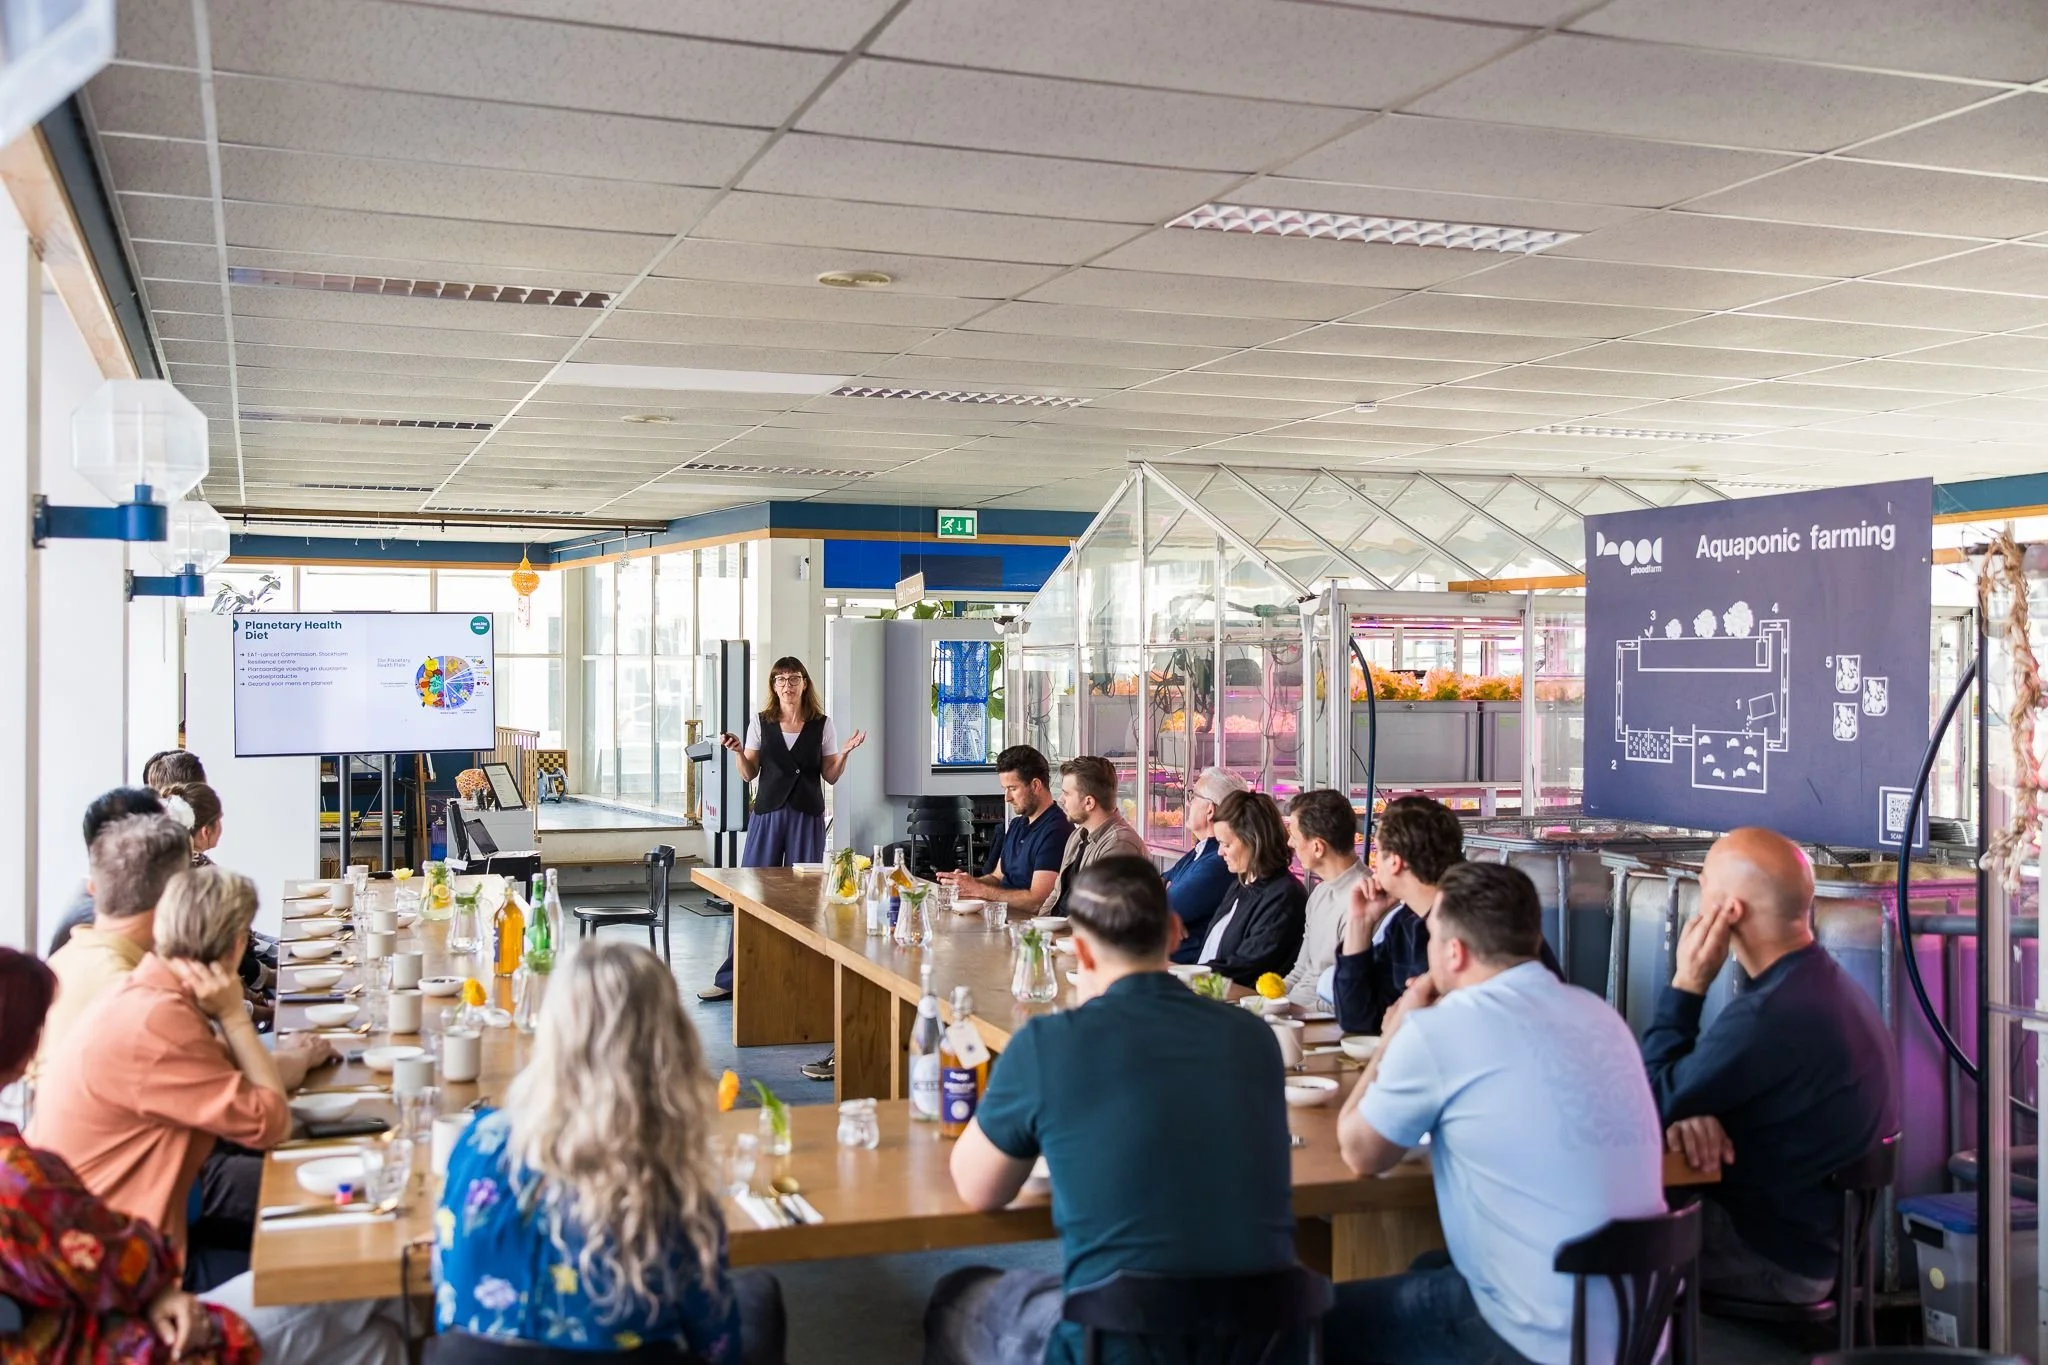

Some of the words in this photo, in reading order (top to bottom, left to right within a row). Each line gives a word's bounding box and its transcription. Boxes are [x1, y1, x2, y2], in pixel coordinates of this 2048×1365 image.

[1696, 527, 1801, 562] Aquaponic
[1810, 520, 1896, 551] farming
[1630, 564, 1662, 577] phoodfarm
[1771, 602, 1779, 614] 4
[1650, 610, 1657, 621] 3
[245, 620, 302, 632] Planetary
[304, 620, 342, 630] Health
[245, 630, 269, 640] Diet
[1825, 655, 1833, 668] 5
[1735, 699, 1741, 710] 1
[1610, 760, 1617, 770] 2
